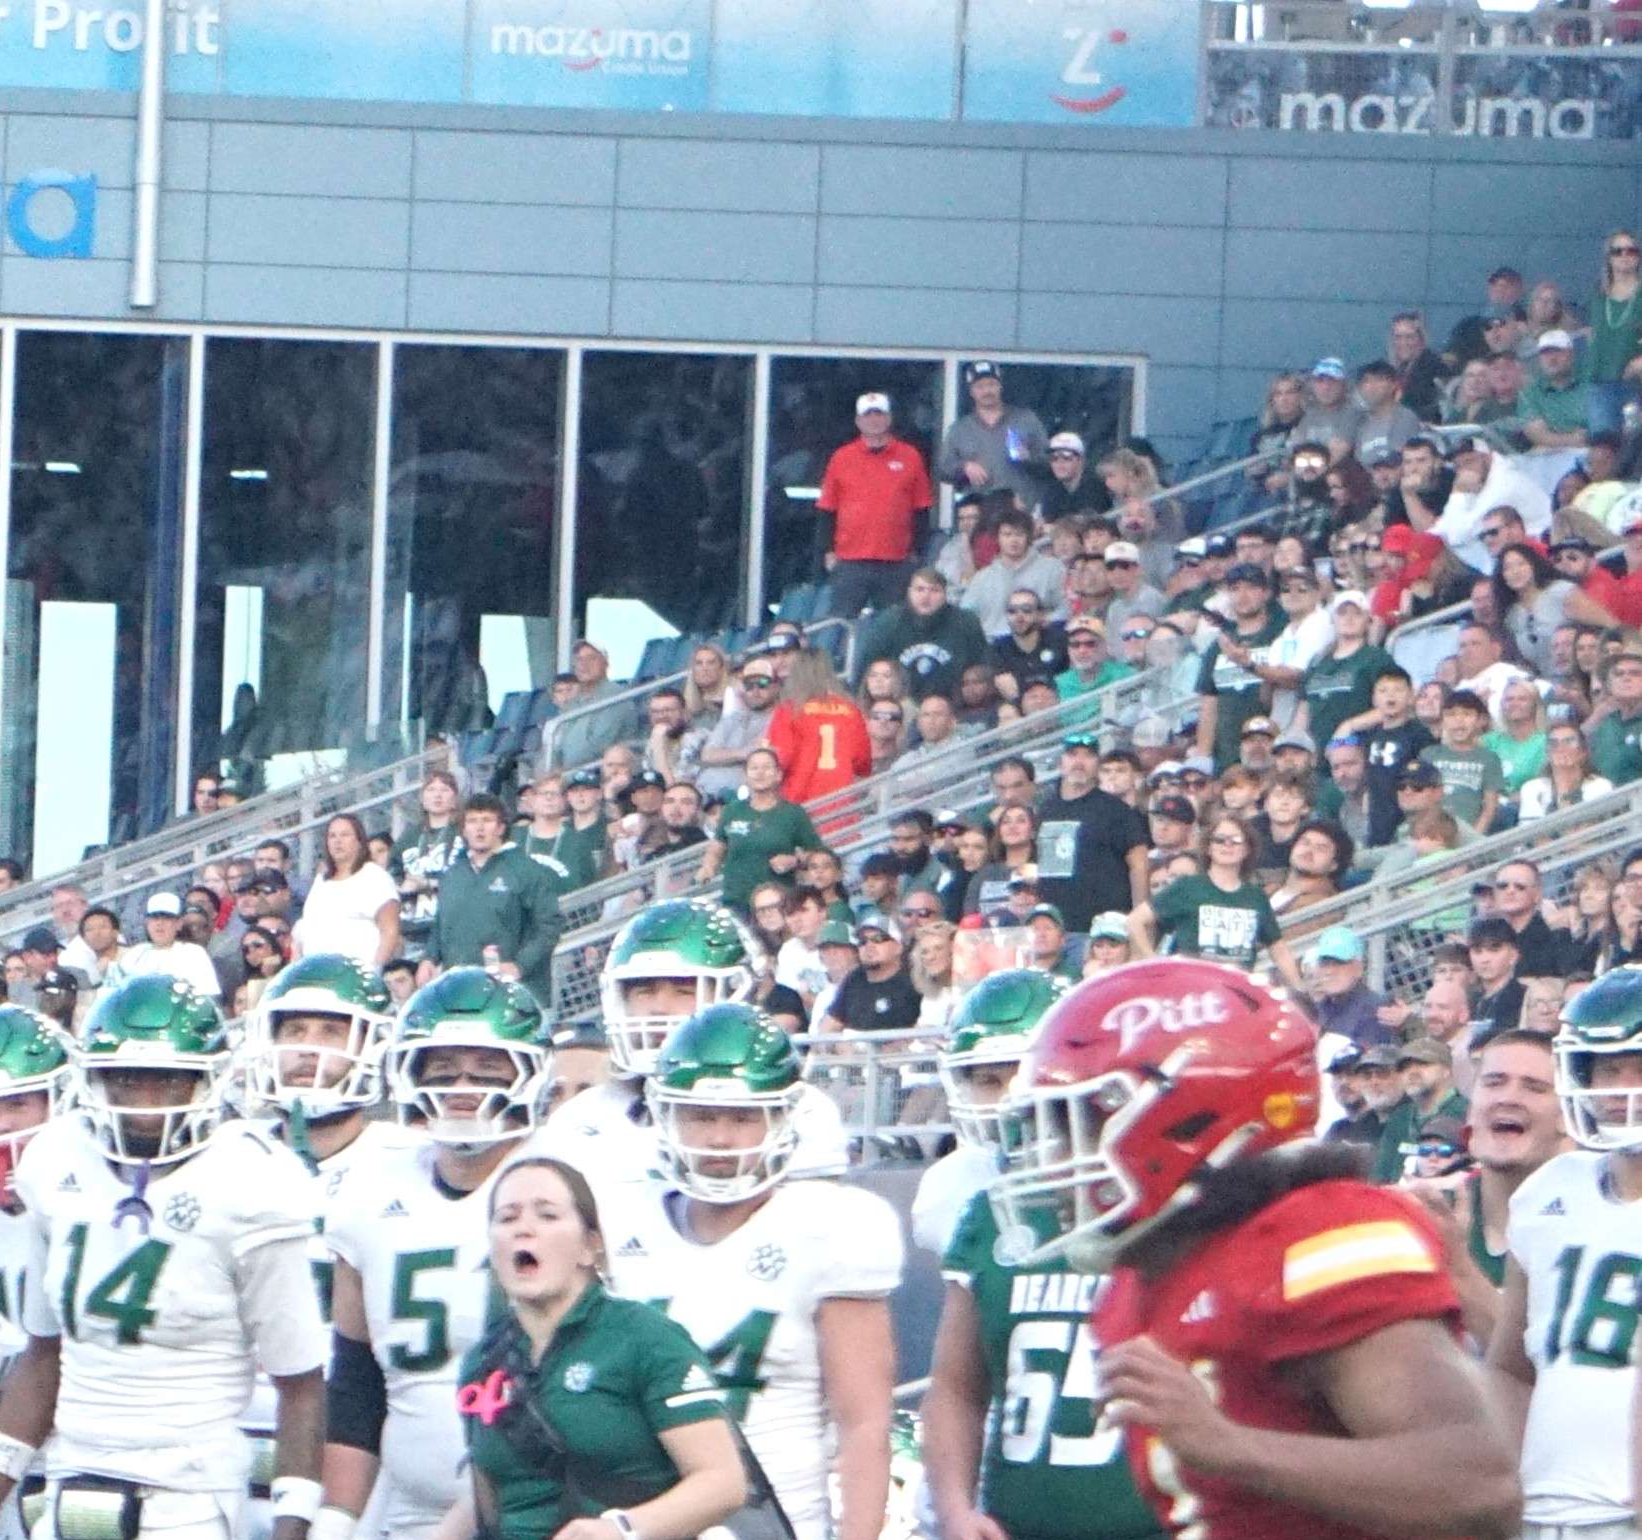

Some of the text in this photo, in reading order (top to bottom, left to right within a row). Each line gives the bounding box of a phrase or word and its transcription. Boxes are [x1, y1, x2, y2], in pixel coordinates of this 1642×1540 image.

[32, 2, 219, 55] Proit
[491, 25, 690, 60] mazuma
[817, 723, 838, 770] 1
[1101, 993, 1228, 1055] Pitt
[62, 1221, 174, 1345] 14
[387, 1247, 483, 1372] 5
